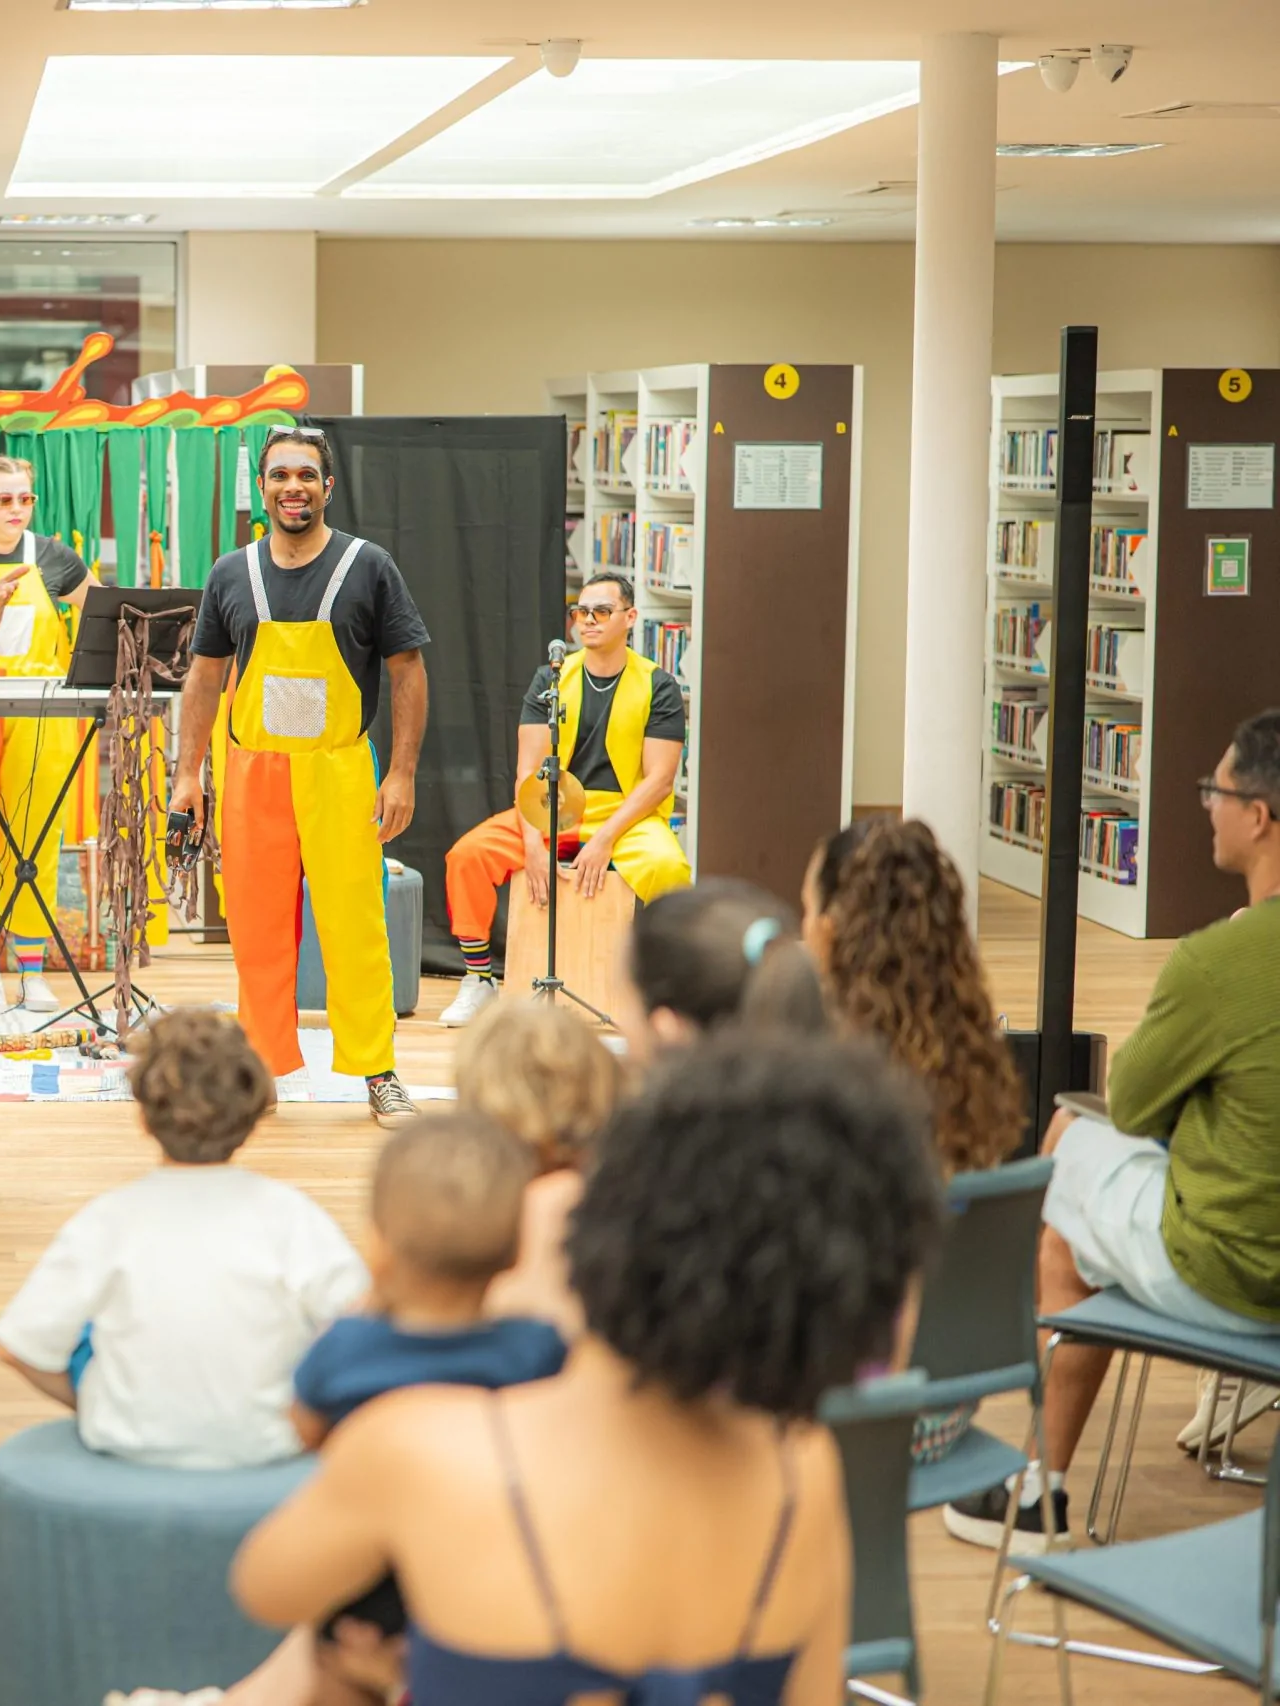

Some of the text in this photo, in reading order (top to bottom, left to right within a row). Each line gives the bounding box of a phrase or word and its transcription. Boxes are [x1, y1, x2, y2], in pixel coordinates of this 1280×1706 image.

[774, 373, 787, 389] 4
[1228, 377, 1241, 393] 5
[713, 422, 725, 434] A
[1168, 425, 1179, 437] A
